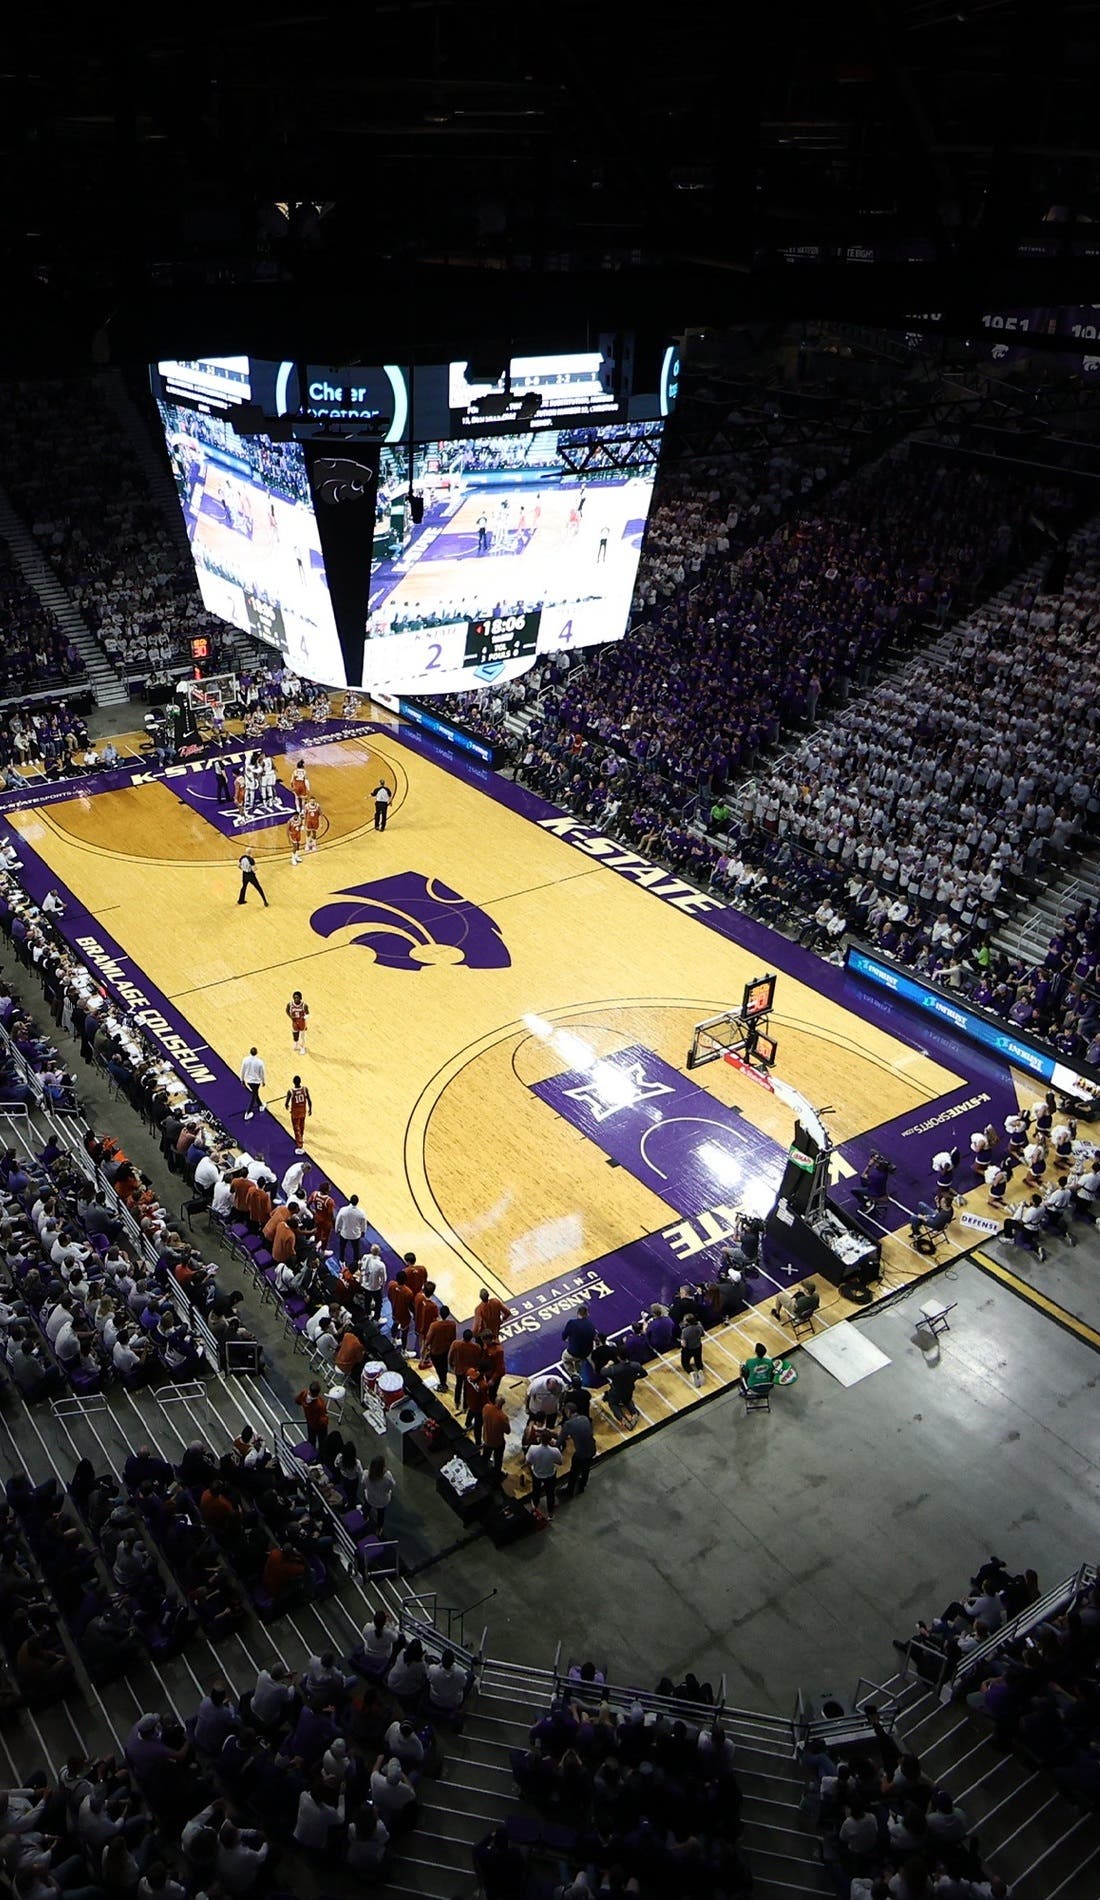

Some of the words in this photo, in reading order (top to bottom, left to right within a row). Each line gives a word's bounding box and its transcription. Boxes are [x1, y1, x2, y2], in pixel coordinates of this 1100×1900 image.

[483, 614, 526, 636] 18:06
[557, 619, 574, 644] 4
[425, 642, 443, 670] 2
[536, 816, 727, 915] K-STATE
[75, 936, 151, 1009] BRAMLAGE
[138, 1009, 217, 1085] COLISEUM
[294, 1093, 305, 1104] 10
[961, 1214, 999, 1232] DEFENSE
[509, 1270, 598, 1317] UNIVERS
[538, 1280, 615, 1321] KANSAS
[498, 1315, 541, 1343] STA
